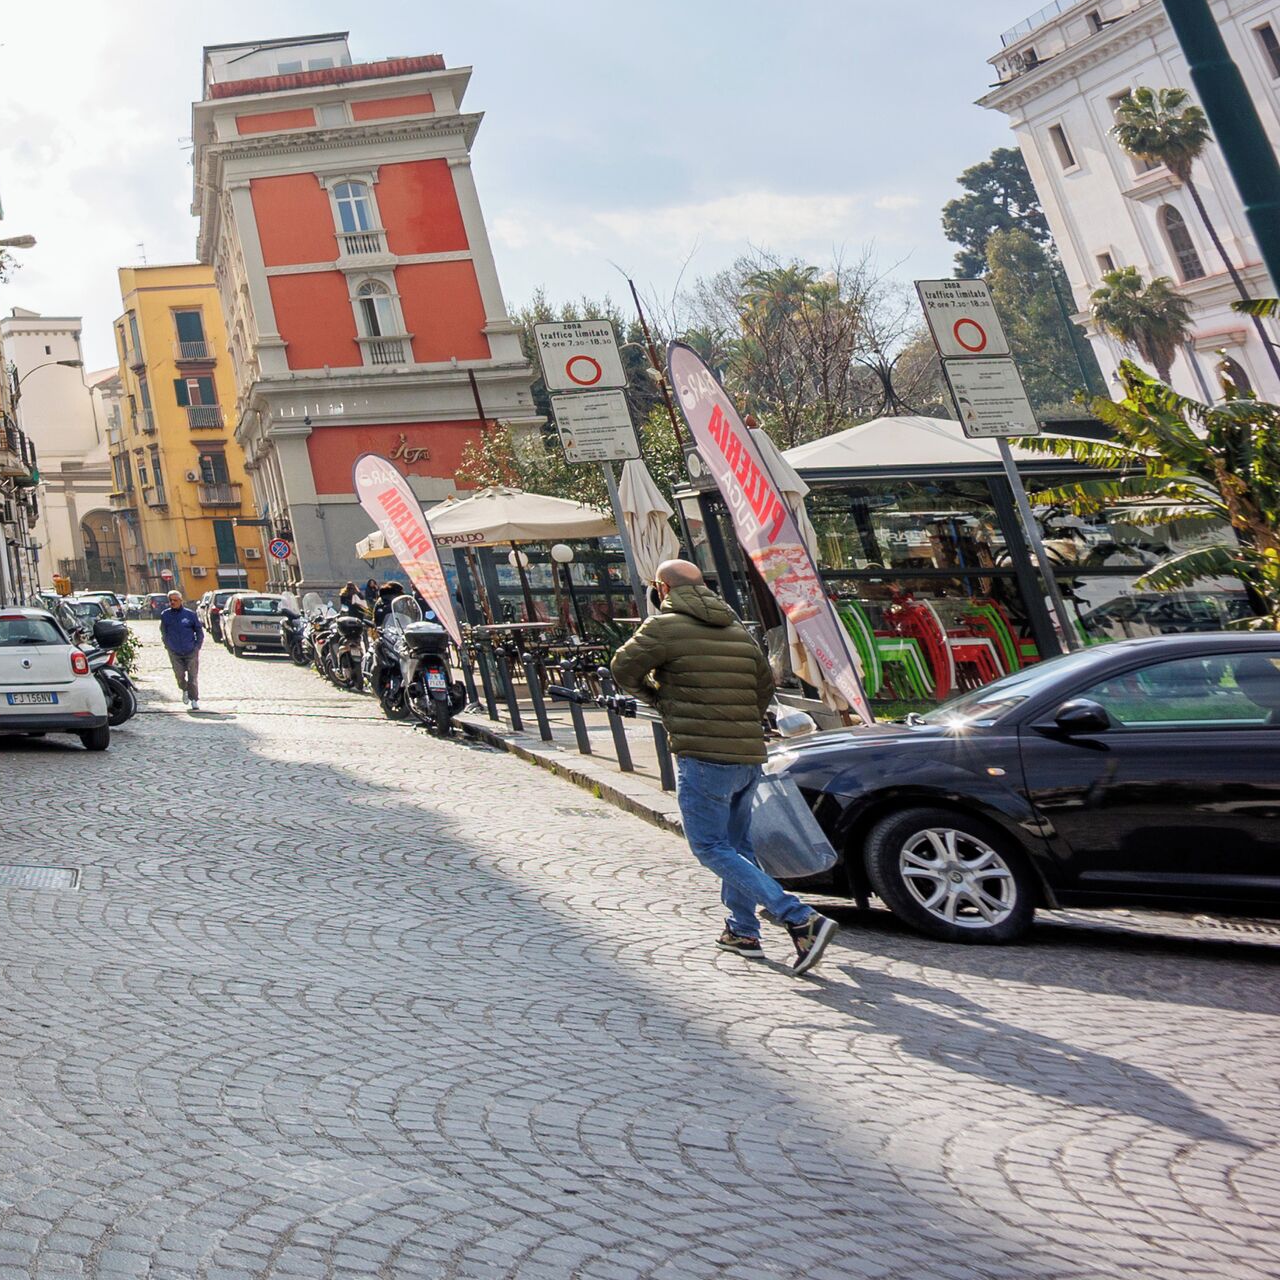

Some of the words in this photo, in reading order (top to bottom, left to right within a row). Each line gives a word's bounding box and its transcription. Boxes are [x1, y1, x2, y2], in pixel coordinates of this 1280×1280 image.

[925, 291, 955, 299] traffico
[540, 331, 573, 340] traffico
[575, 330, 609, 338] limitato
[435, 532, 485, 546] TORALDO
[13, 694, 23, 704] FJ
[28, 694, 51, 704] 156NV
